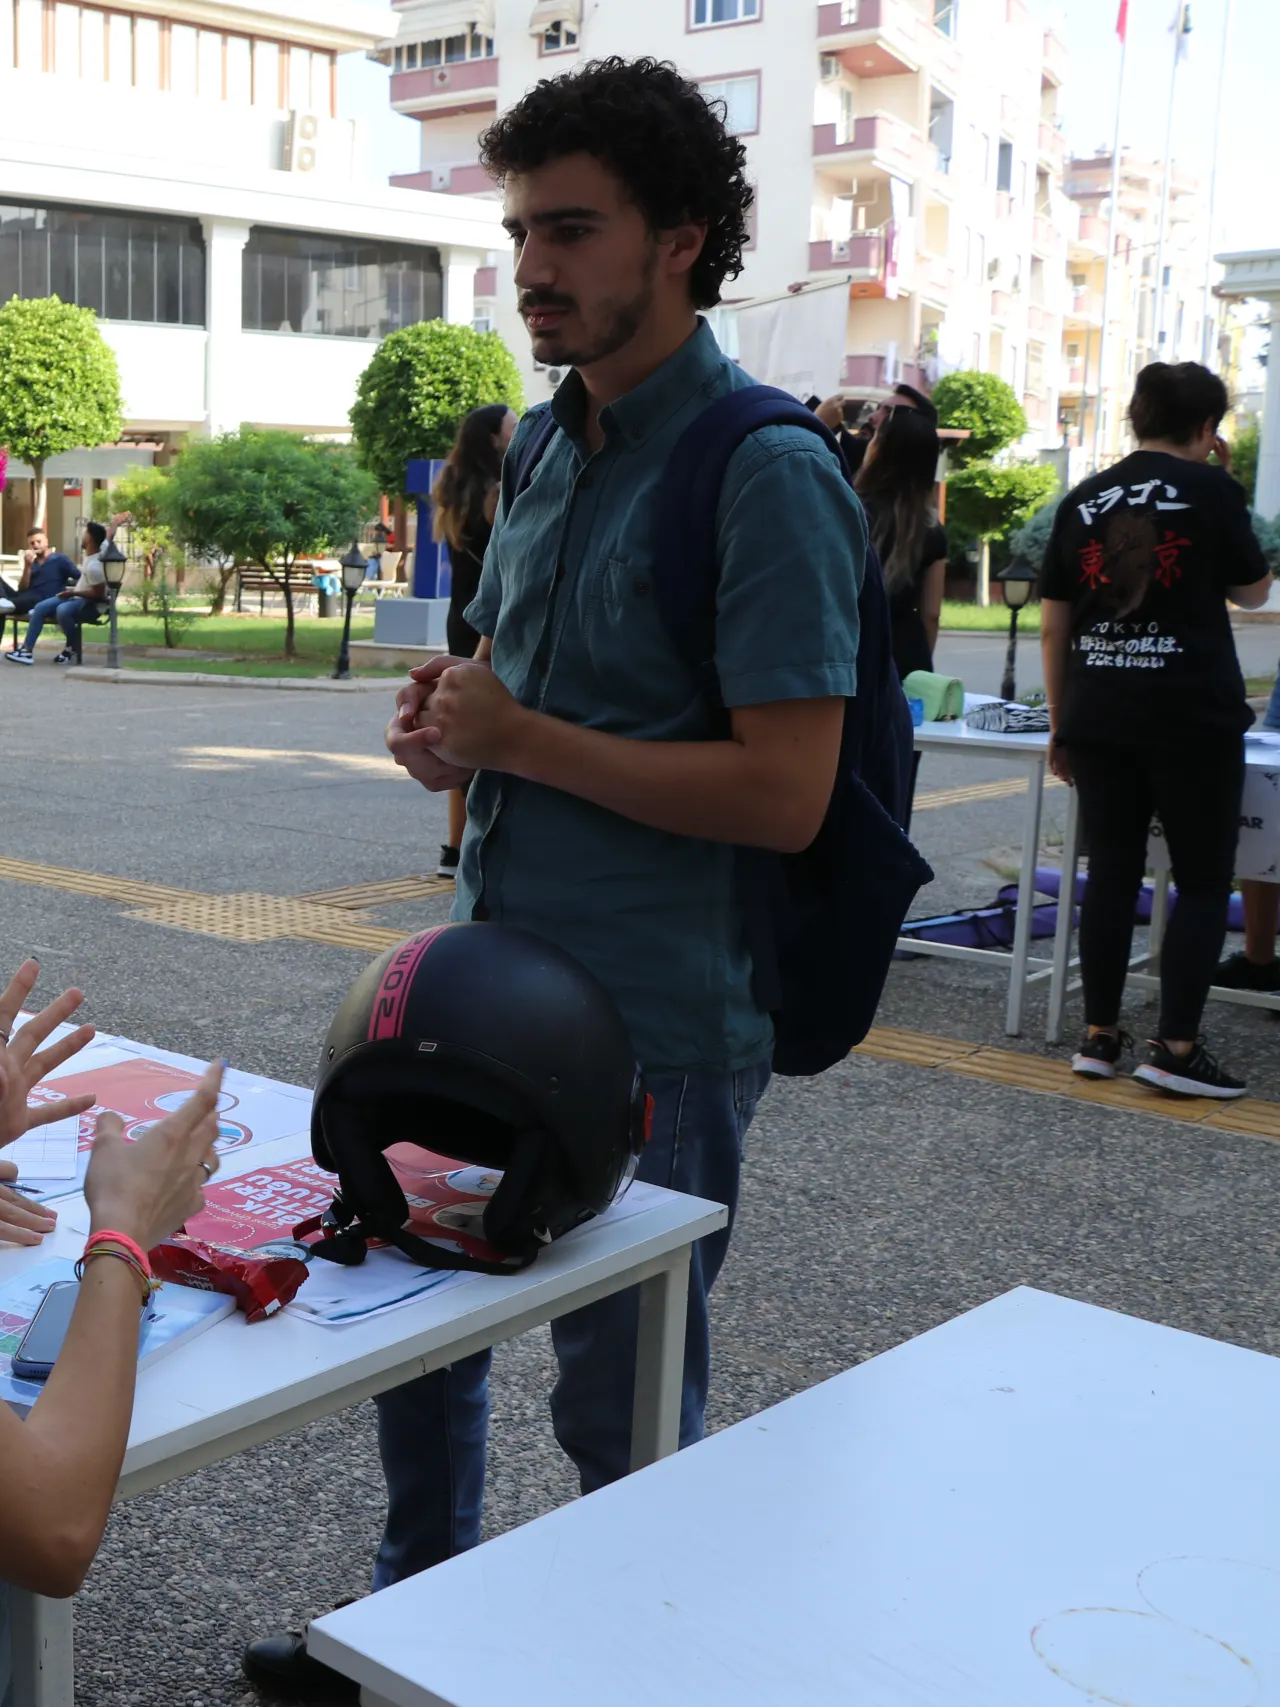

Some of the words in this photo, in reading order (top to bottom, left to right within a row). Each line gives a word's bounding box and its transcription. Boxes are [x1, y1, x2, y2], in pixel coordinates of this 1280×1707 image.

[1077, 479, 1193, 526] ドラゴン
[219, 1181, 323, 1218] ETLERİ
[231, 1199, 305, 1226] ĞLIK
